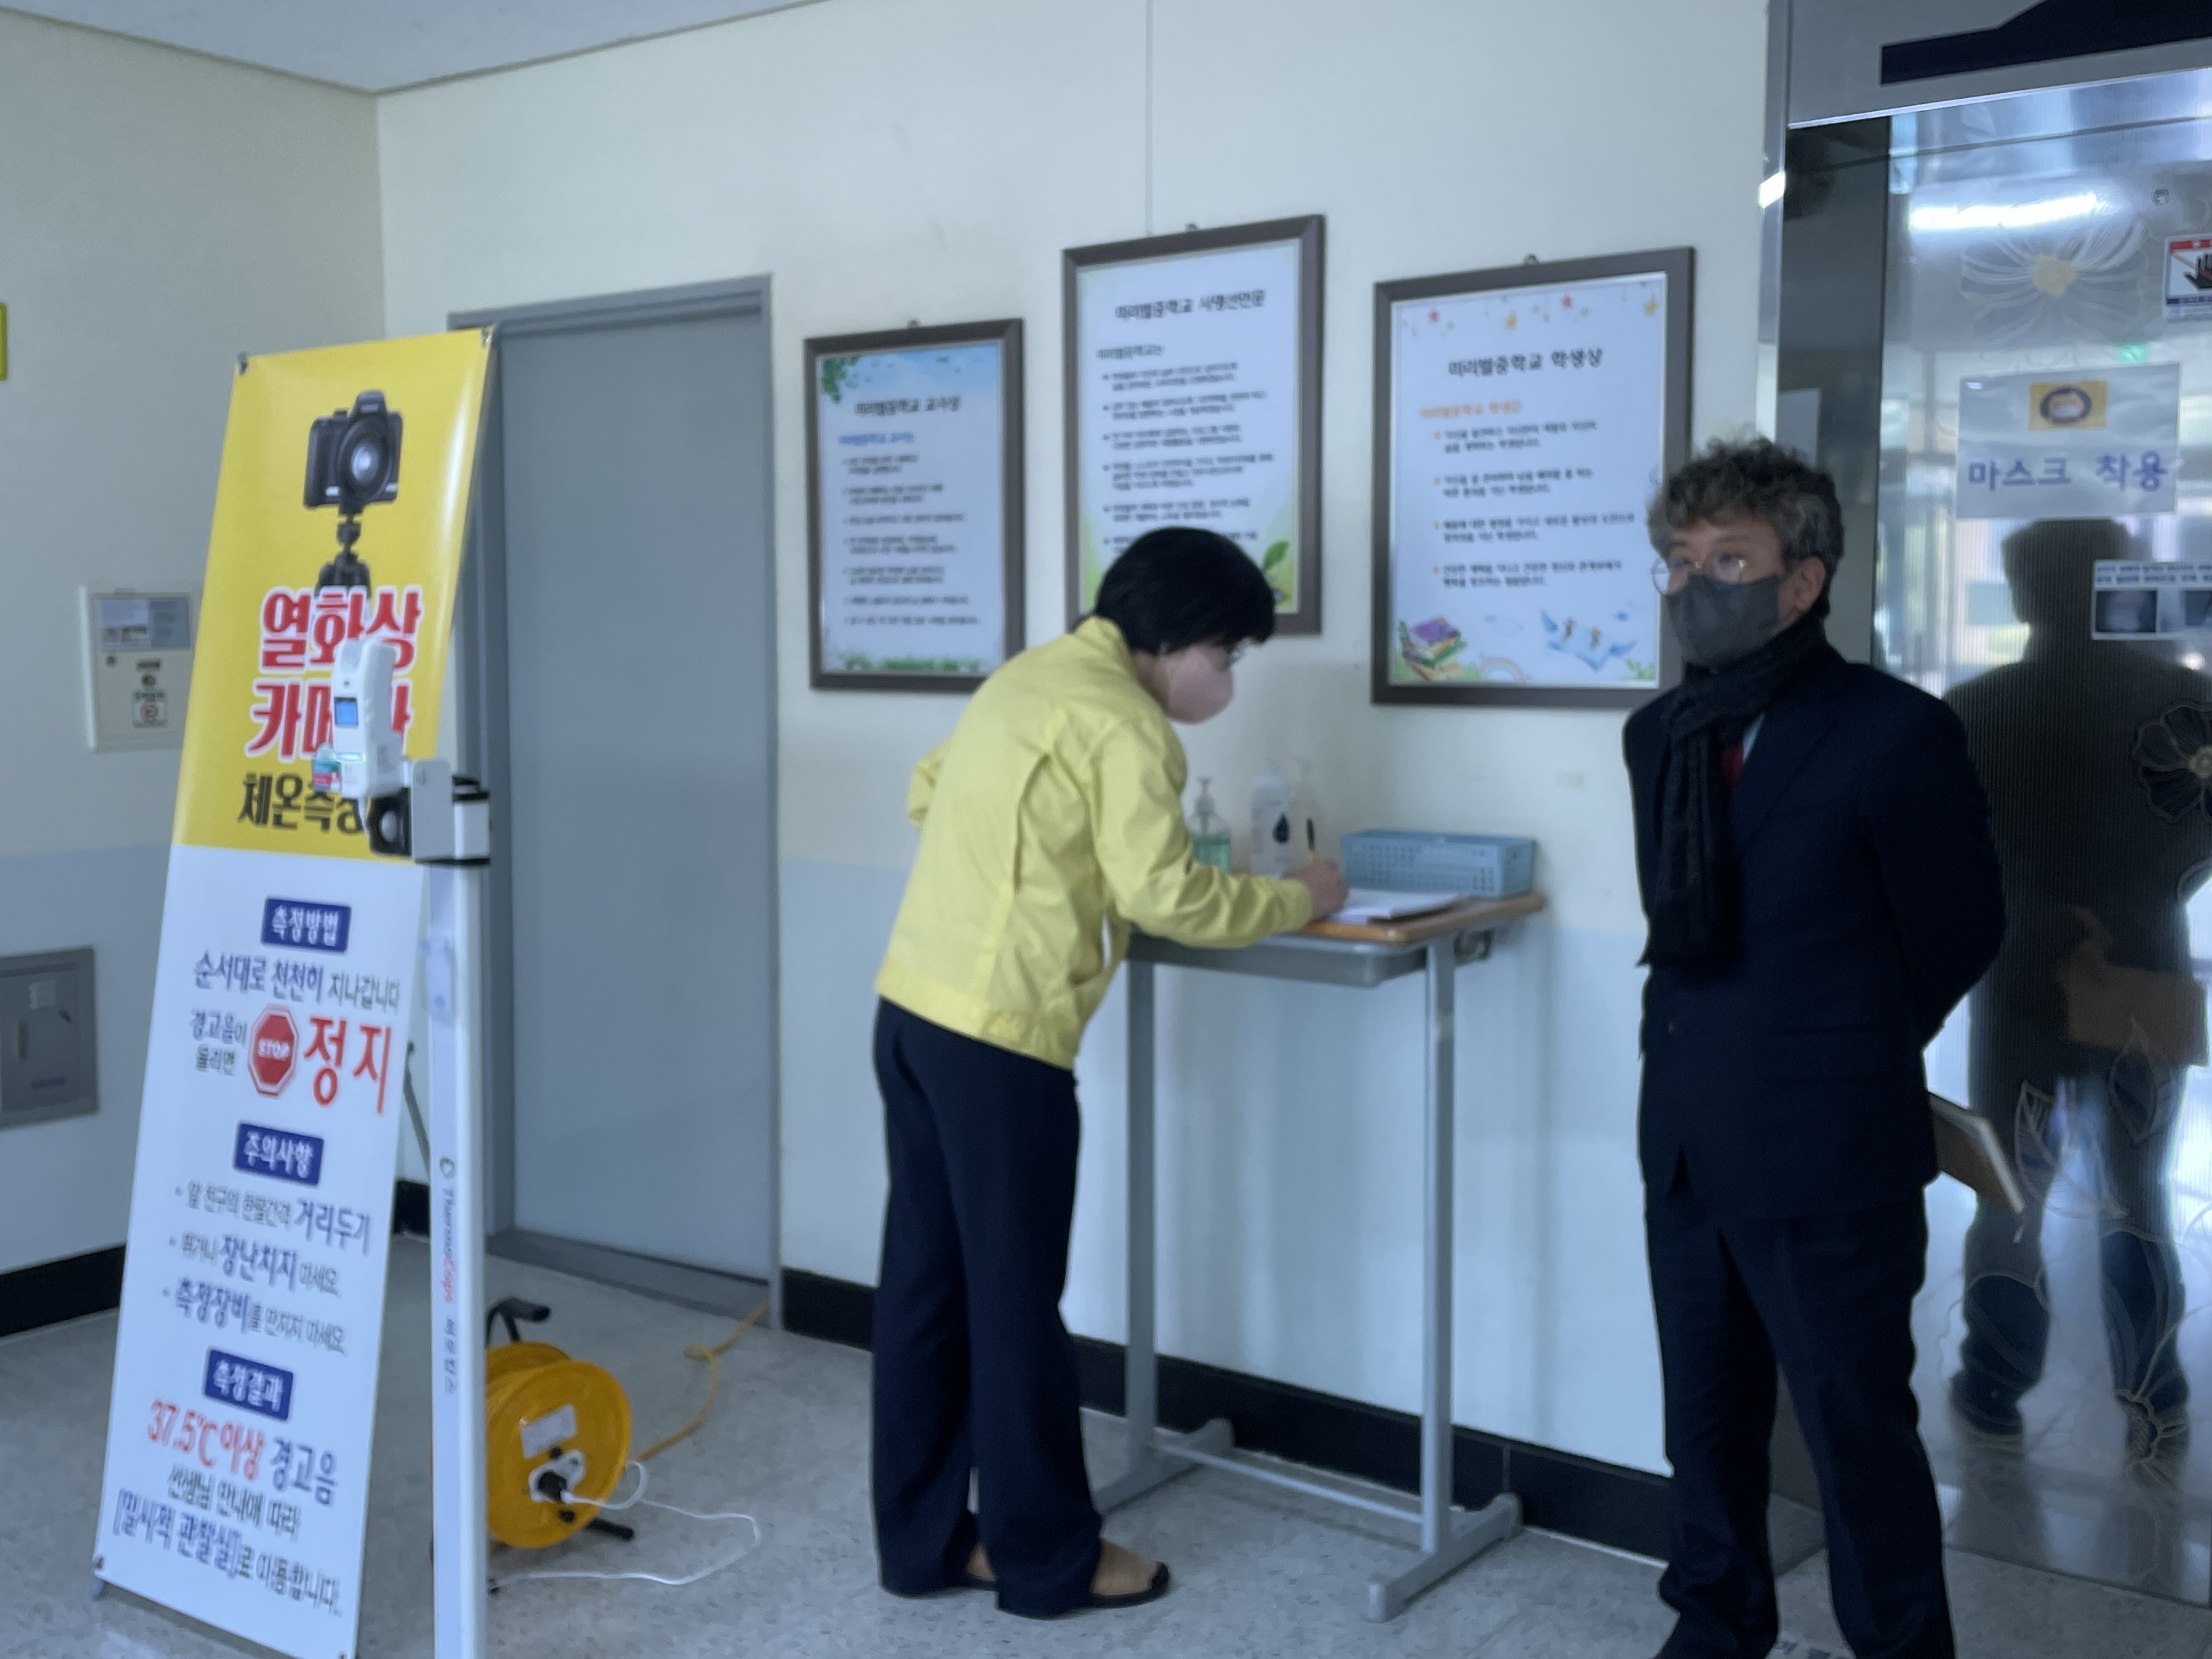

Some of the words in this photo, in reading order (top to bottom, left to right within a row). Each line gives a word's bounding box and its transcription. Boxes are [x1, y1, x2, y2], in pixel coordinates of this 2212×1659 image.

[1551, 347, 1603, 369] 학생상
[1968, 457, 2072, 493] 마스크
[2096, 449, 2168, 493] 착용
[261, 588, 422, 672] 열화상
[272, 904, 340, 947] 측정방법
[194, 951, 268, 994] 순서대로
[272, 957, 324, 1005] 천천히
[257, 1039, 290, 1060] STOP
[244, 1131, 312, 1179] 주의사항
[295, 1198, 373, 1256] 거리두기
[219, 1234, 297, 1292] 장난치지
[213, 1359, 284, 1412] 측정결과
[270, 1436, 337, 1508] 경고음
